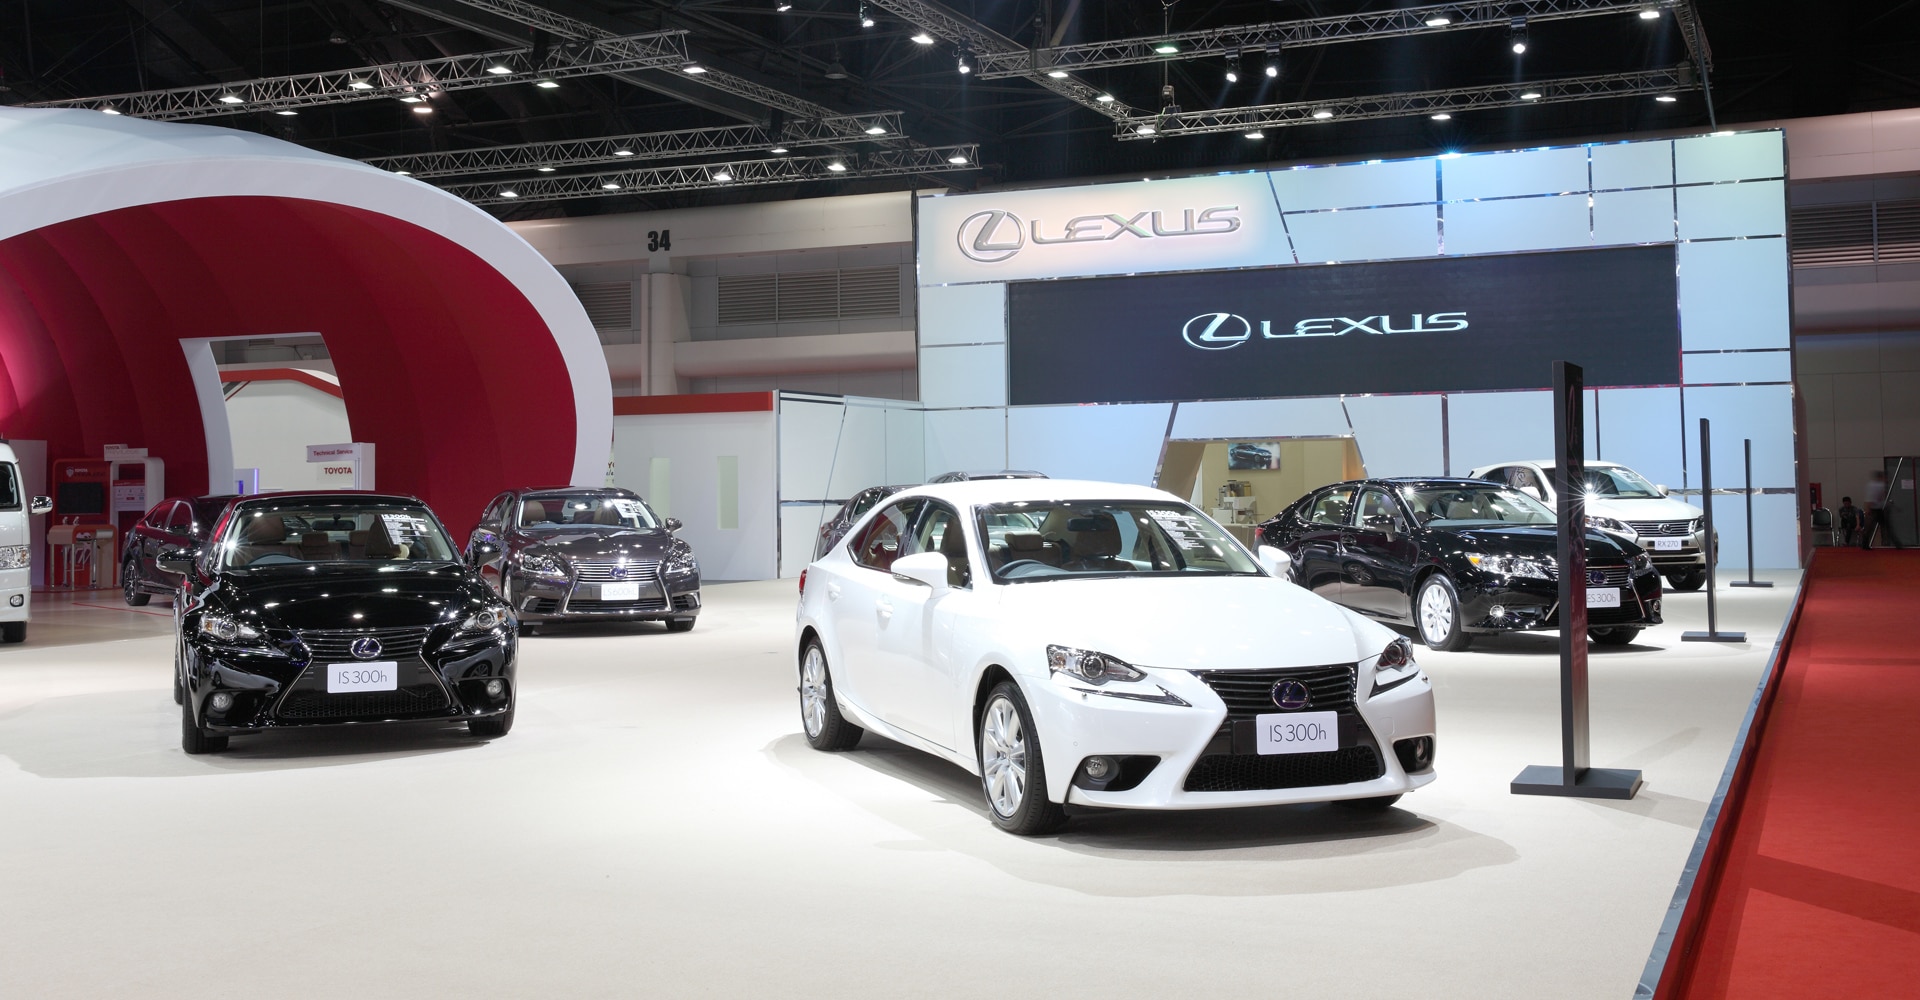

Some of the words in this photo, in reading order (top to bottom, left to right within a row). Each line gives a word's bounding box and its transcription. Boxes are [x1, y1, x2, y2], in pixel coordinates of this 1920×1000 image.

[1030, 205, 1242, 245] LEXUS
[647, 229, 671, 252] 34
[1260, 311, 1469, 339] LEXUS
[352, 670, 387, 684] 300h
[1285, 723, 1327, 742] 300h
